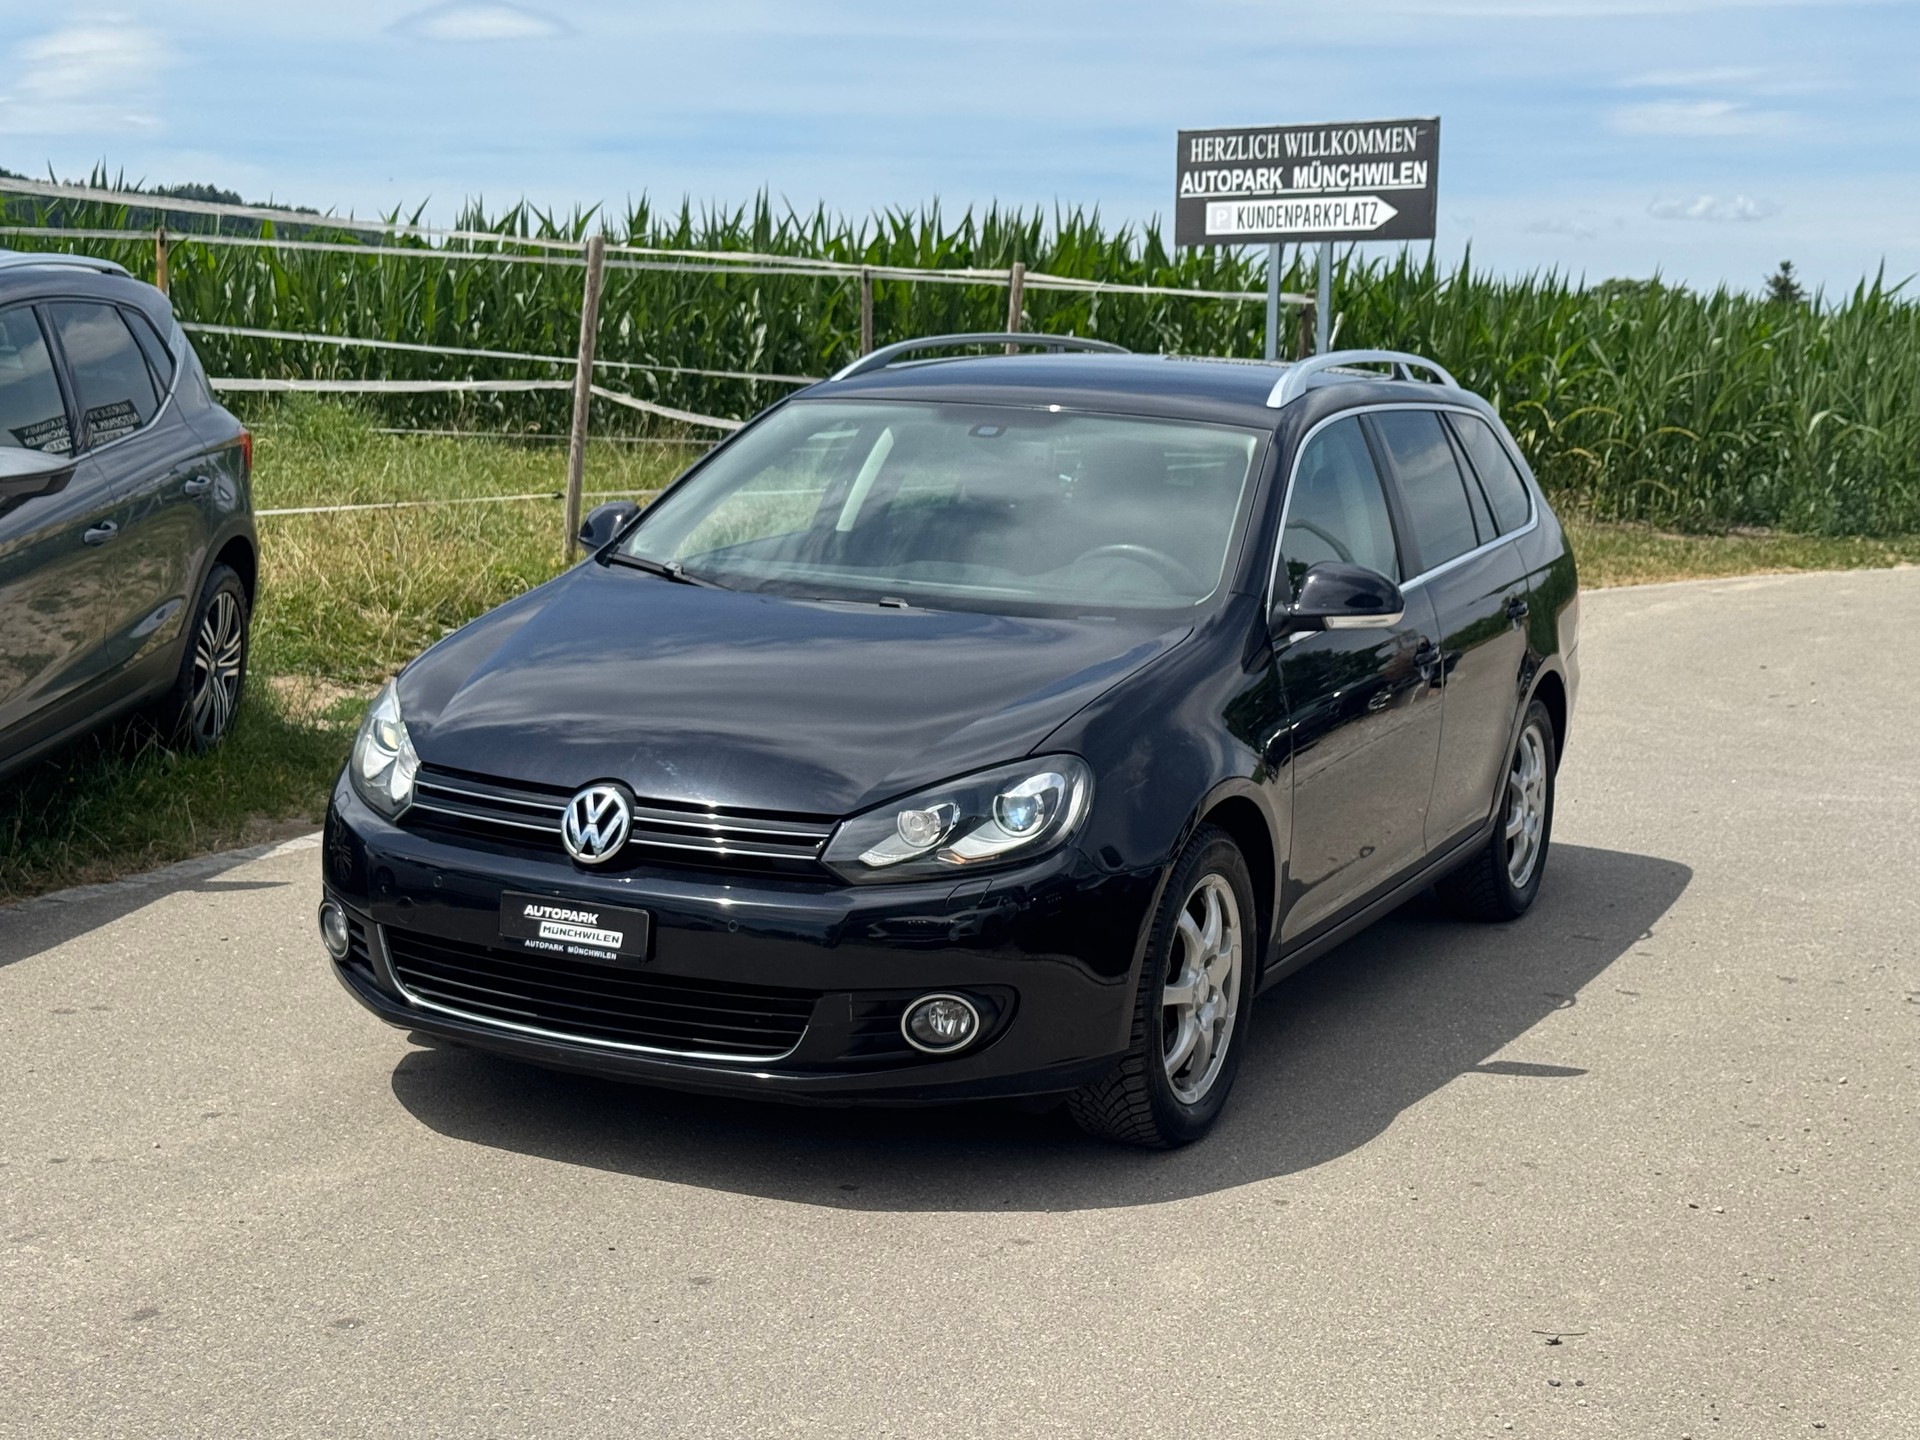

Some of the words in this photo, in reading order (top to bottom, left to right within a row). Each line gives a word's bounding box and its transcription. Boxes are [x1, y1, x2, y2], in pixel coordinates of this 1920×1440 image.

[1190, 133, 1280, 162] HERZLICH
[1284, 127, 1417, 158] WILLKOMMEN
[1180, 167, 1283, 194] AUTOPARK
[1293, 160, 1427, 188] MÜNCHWILEN
[1237, 202, 1378, 230] KUNDENPARKPLATZ
[563, 788, 629, 863] VW
[524, 904, 599, 924] AUTOPARK
[542, 925, 620, 944] MÜNCHWILEN
[524, 939, 564, 952] AUTOPARK
[567, 945, 617, 960] MÜNCHWILEN
